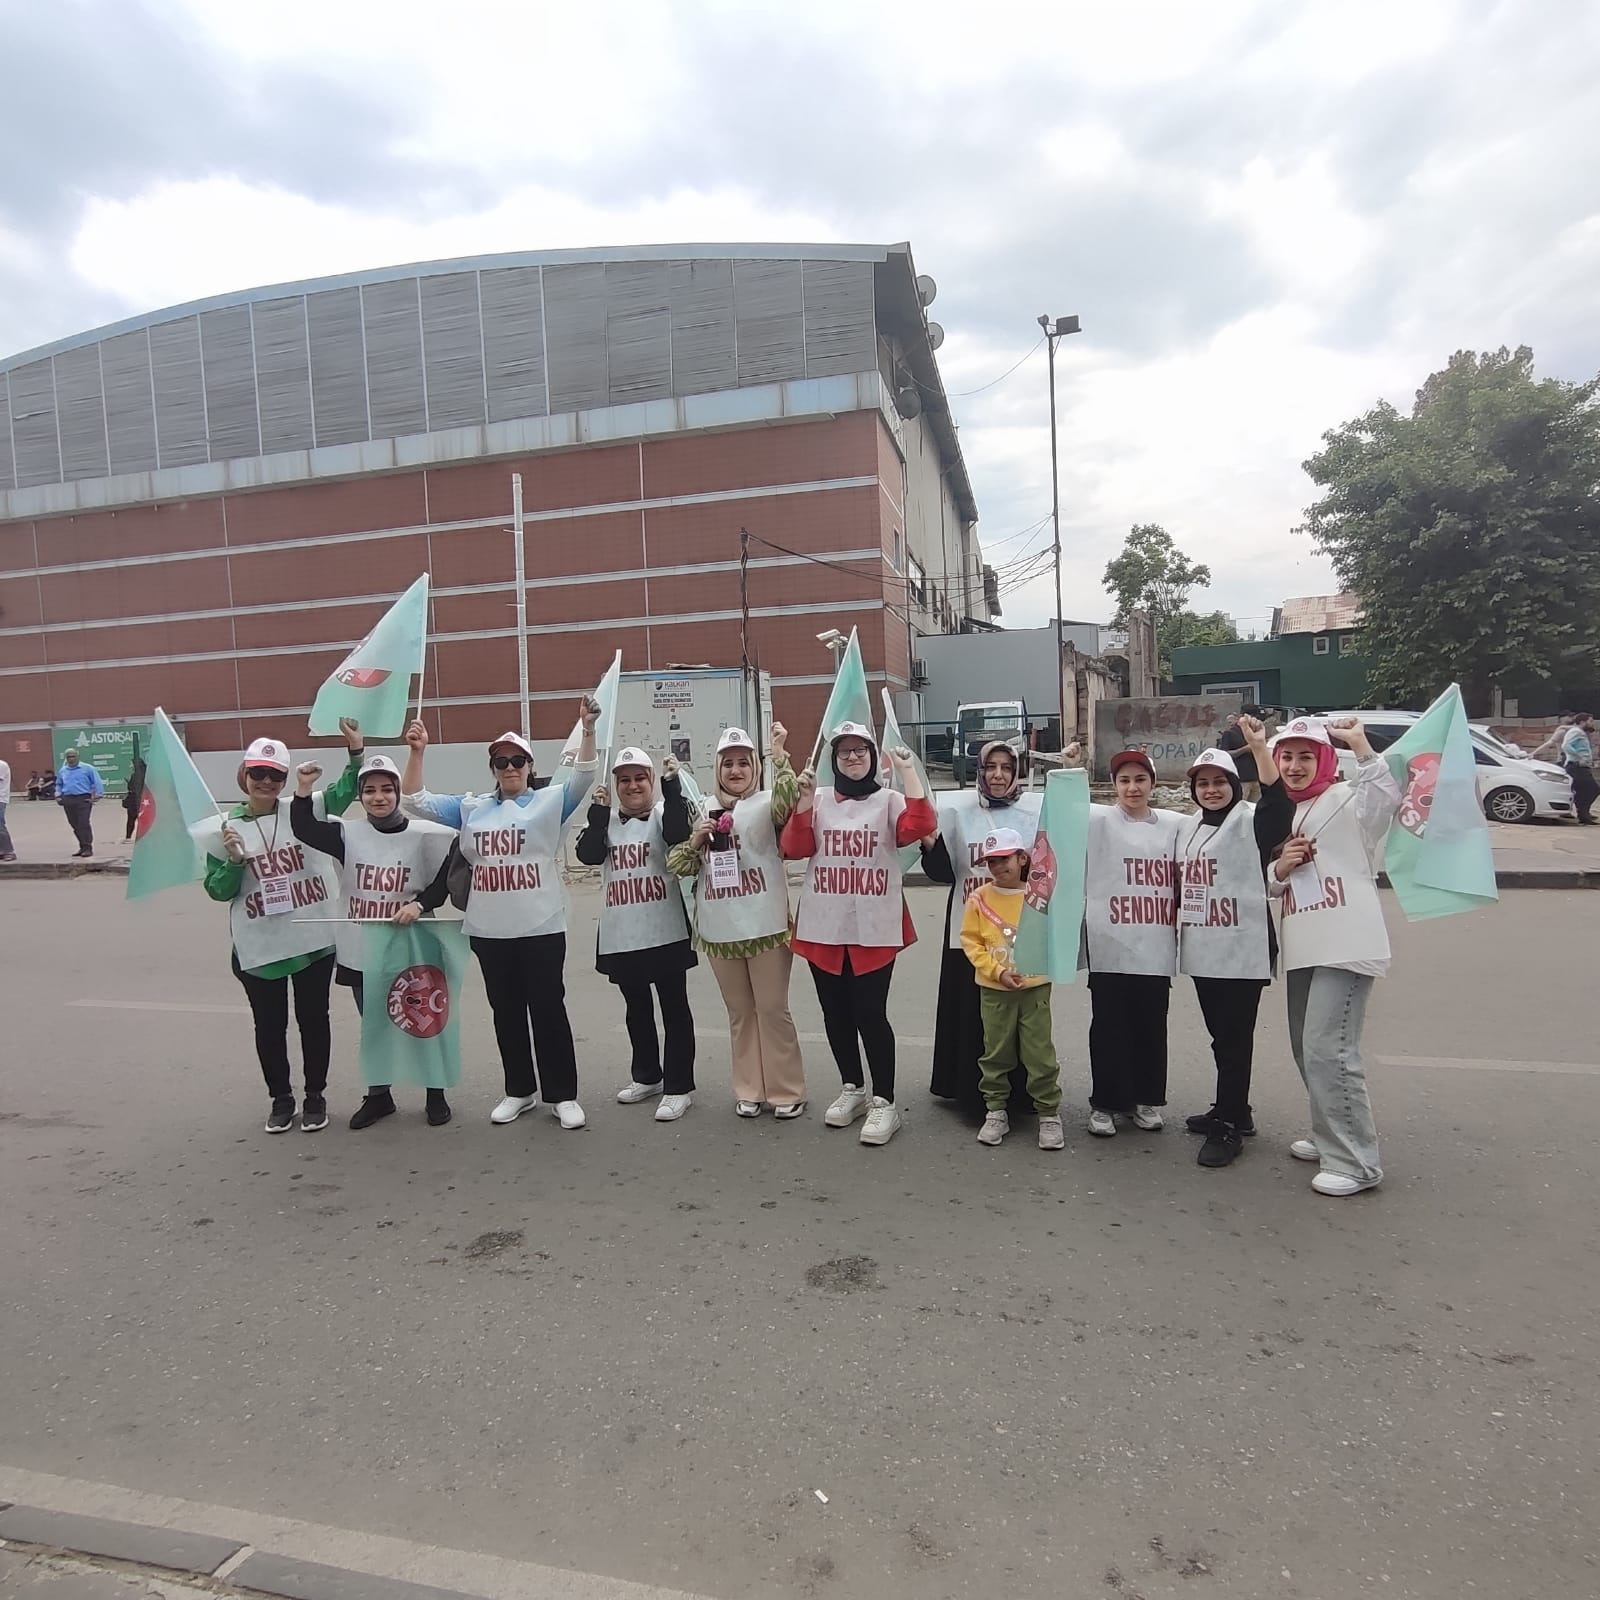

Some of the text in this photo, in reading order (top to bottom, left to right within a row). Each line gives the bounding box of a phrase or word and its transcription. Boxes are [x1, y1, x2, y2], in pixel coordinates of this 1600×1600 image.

[473, 823, 526, 857] TEKSİF
[607, 840, 651, 872] TEKSİF
[823, 823, 879, 858] TEKSİF
[246, 841, 305, 881] TEKSİF
[355, 860, 411, 893] TEKSİF
[473, 859, 541, 892] SENDİKASI
[813, 860, 889, 897] SENDİKASI
[606, 872, 667, 908] ENDİKASI
[389, 970, 414, 1030] TEKSİF
